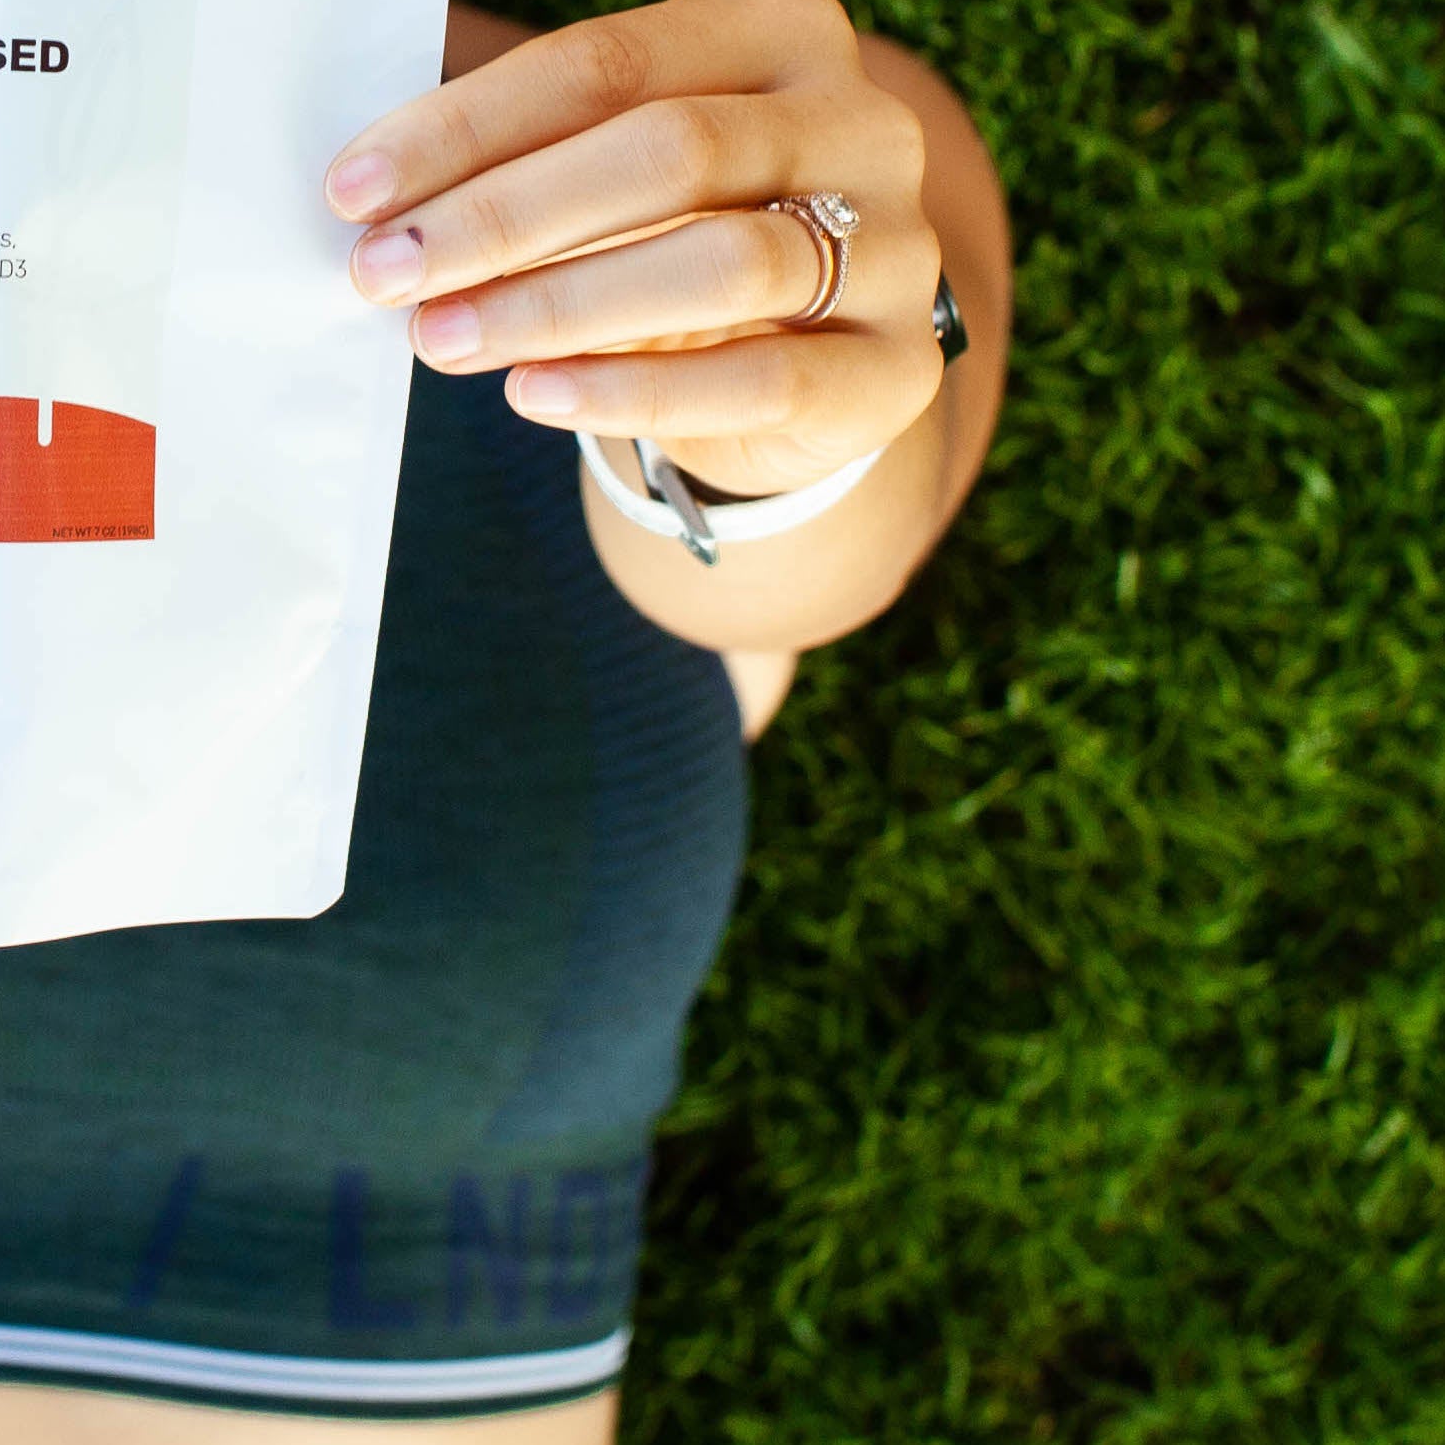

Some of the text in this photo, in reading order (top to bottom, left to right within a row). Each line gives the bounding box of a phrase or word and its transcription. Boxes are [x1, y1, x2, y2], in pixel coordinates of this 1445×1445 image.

[0, 258, 28, 279] D3
[52, 526, 74, 538] NET
[74, 525, 93, 537] WT
[101, 525, 116, 538] OZ
